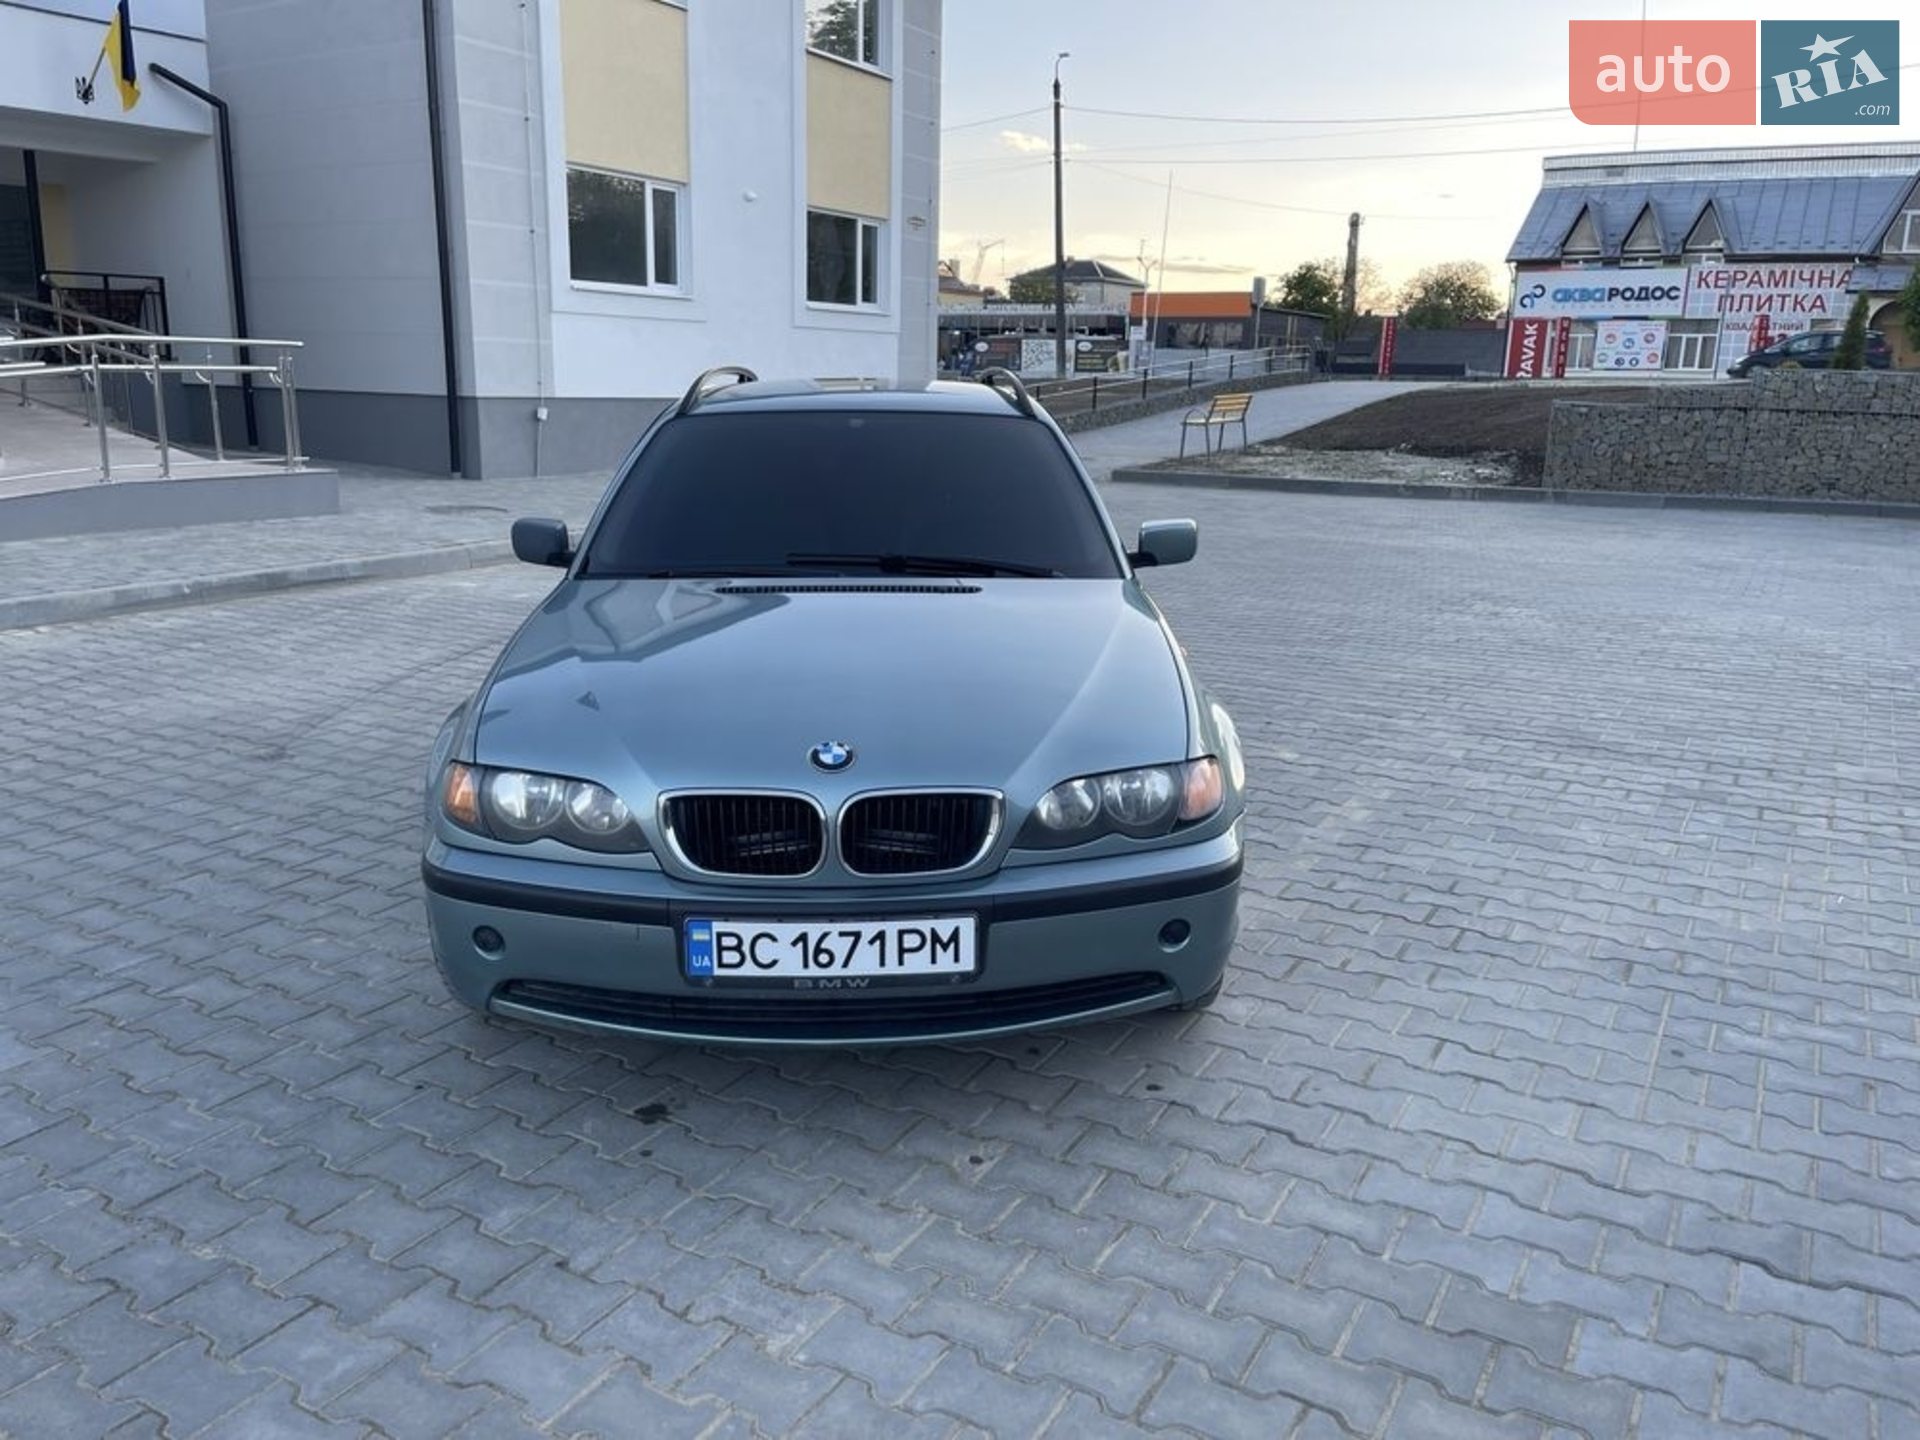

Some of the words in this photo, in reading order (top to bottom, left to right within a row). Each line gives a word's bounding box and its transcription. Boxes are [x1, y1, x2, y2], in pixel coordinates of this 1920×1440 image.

[1717, 293, 1827, 313] ПЛИТКА
[692, 955, 711, 968] UA
[793, 978, 870, 988] BMW
